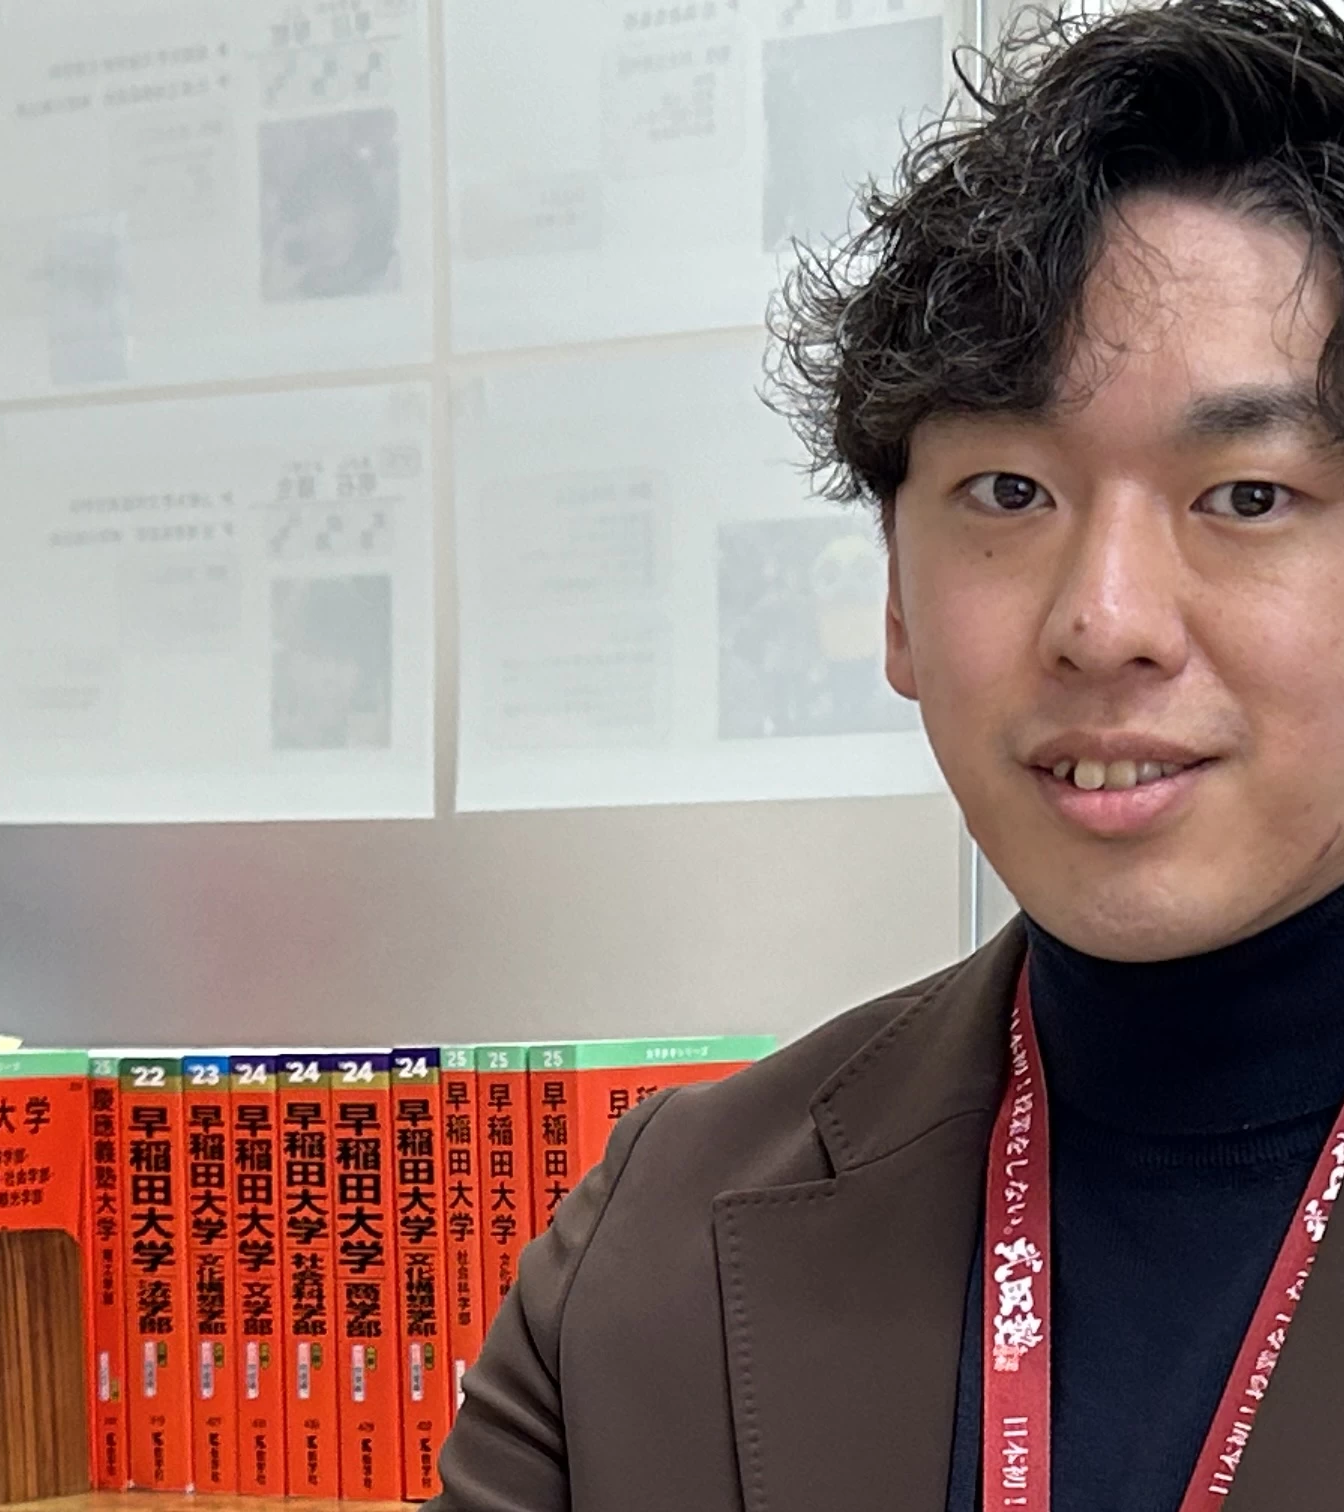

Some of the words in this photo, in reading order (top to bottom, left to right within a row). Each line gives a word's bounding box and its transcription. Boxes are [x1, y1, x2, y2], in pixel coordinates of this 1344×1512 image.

[128, 1106, 175, 1273] 早稲田大学
[188, 1105, 228, 1245] 早稲田大学
[234, 1105, 275, 1273] 早稲田大学
[283, 1102, 328, 1245] 早稲田大学
[335, 1103, 385, 1274] 早稲田大学
[396, 1099, 438, 1244] 早稲田大学
[445, 1081, 474, 1241] 早稲田大学
[487, 1083, 516, 1245] 早稲田大学
[542, 1081, 569, 1228] 早稲田大
[241, 1281, 273, 1335] 文学部
